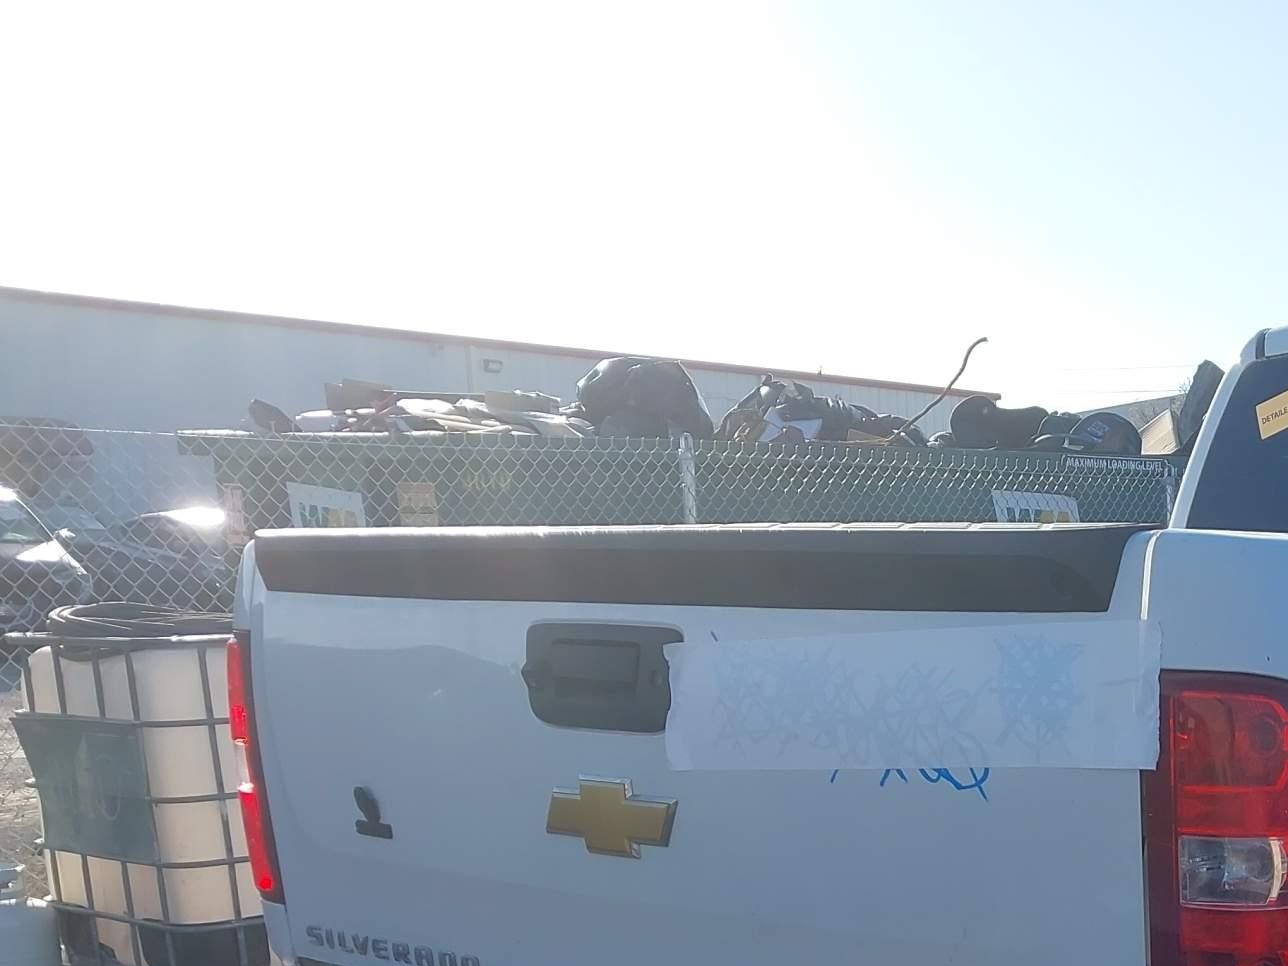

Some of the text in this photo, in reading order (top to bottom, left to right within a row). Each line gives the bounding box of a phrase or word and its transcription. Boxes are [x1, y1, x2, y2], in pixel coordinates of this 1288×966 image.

[1067, 457, 1163, 471] MAXIMUM LOADING LEVEL
